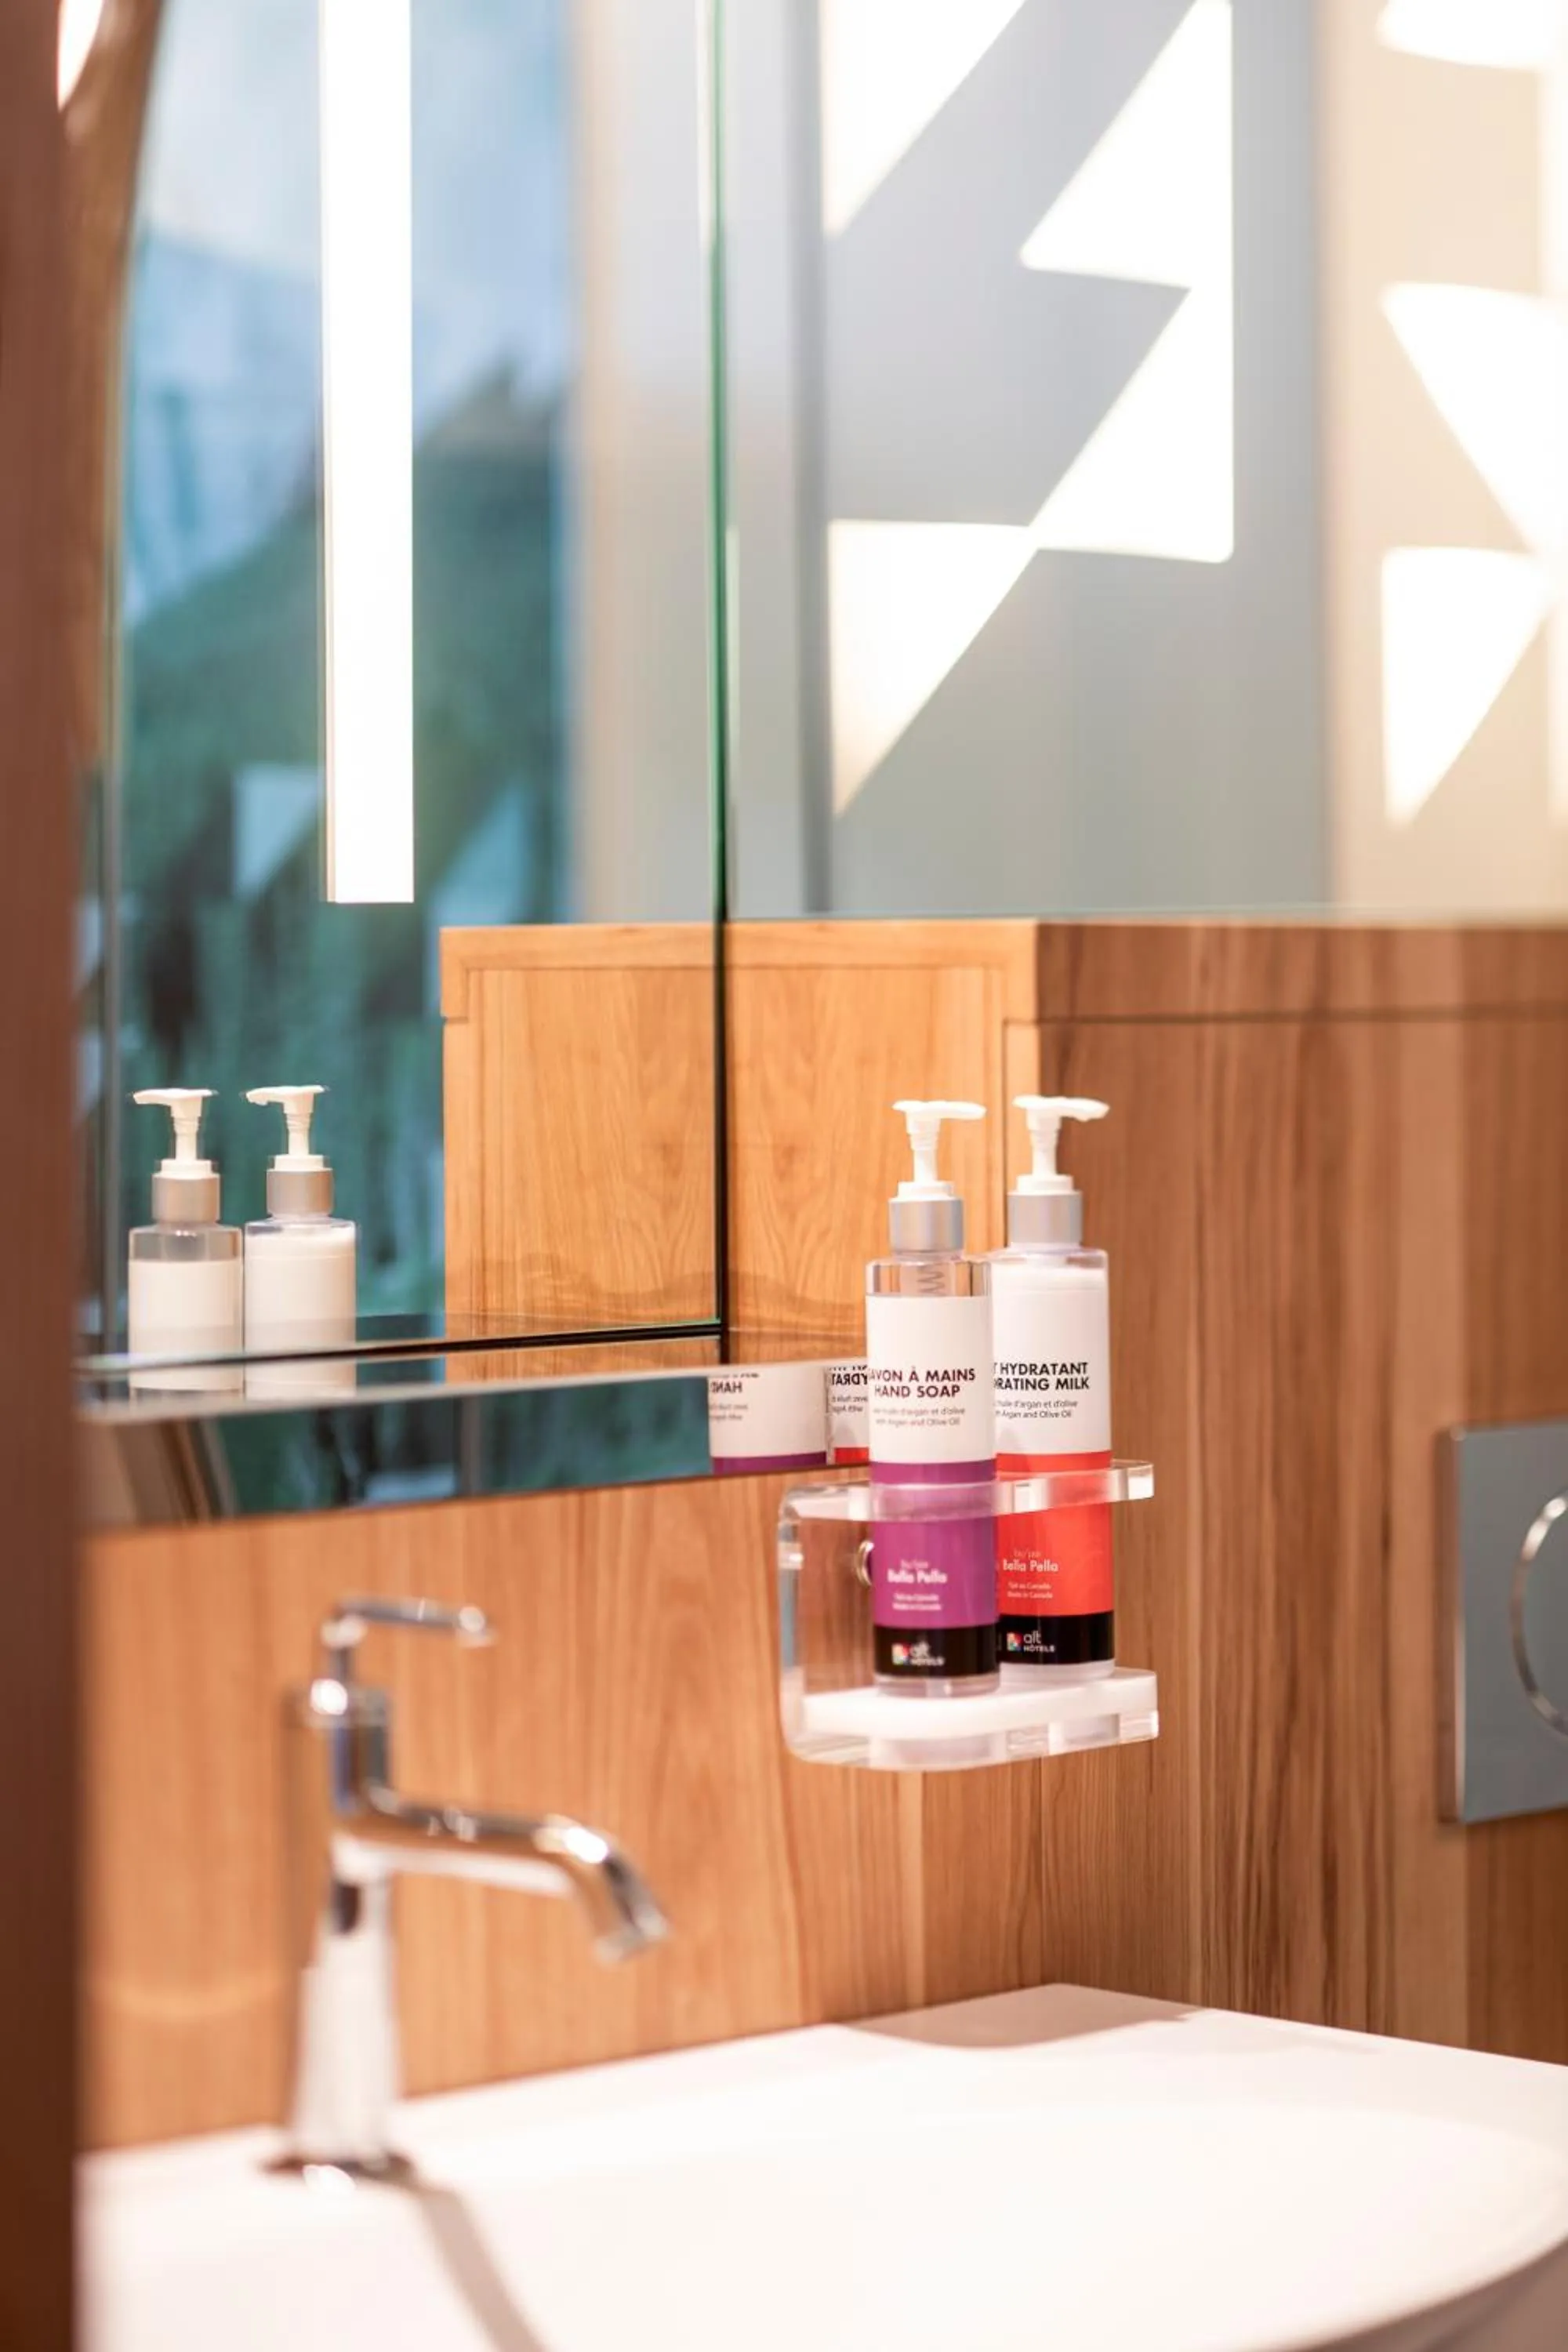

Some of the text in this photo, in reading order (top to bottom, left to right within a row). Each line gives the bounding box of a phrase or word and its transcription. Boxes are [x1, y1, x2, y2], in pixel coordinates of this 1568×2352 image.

[909, 1366, 919, 1382] À
[925, 1368, 975, 1382] MAINS
[1000, 1362, 1088, 1375] HYDRATANT
[1054, 1377, 1090, 1390] MILK
[874, 1384, 960, 1399] HAND SOAP
[1029, 1559, 1058, 1572] Pella
[1023, 1630, 1042, 1644] alt
